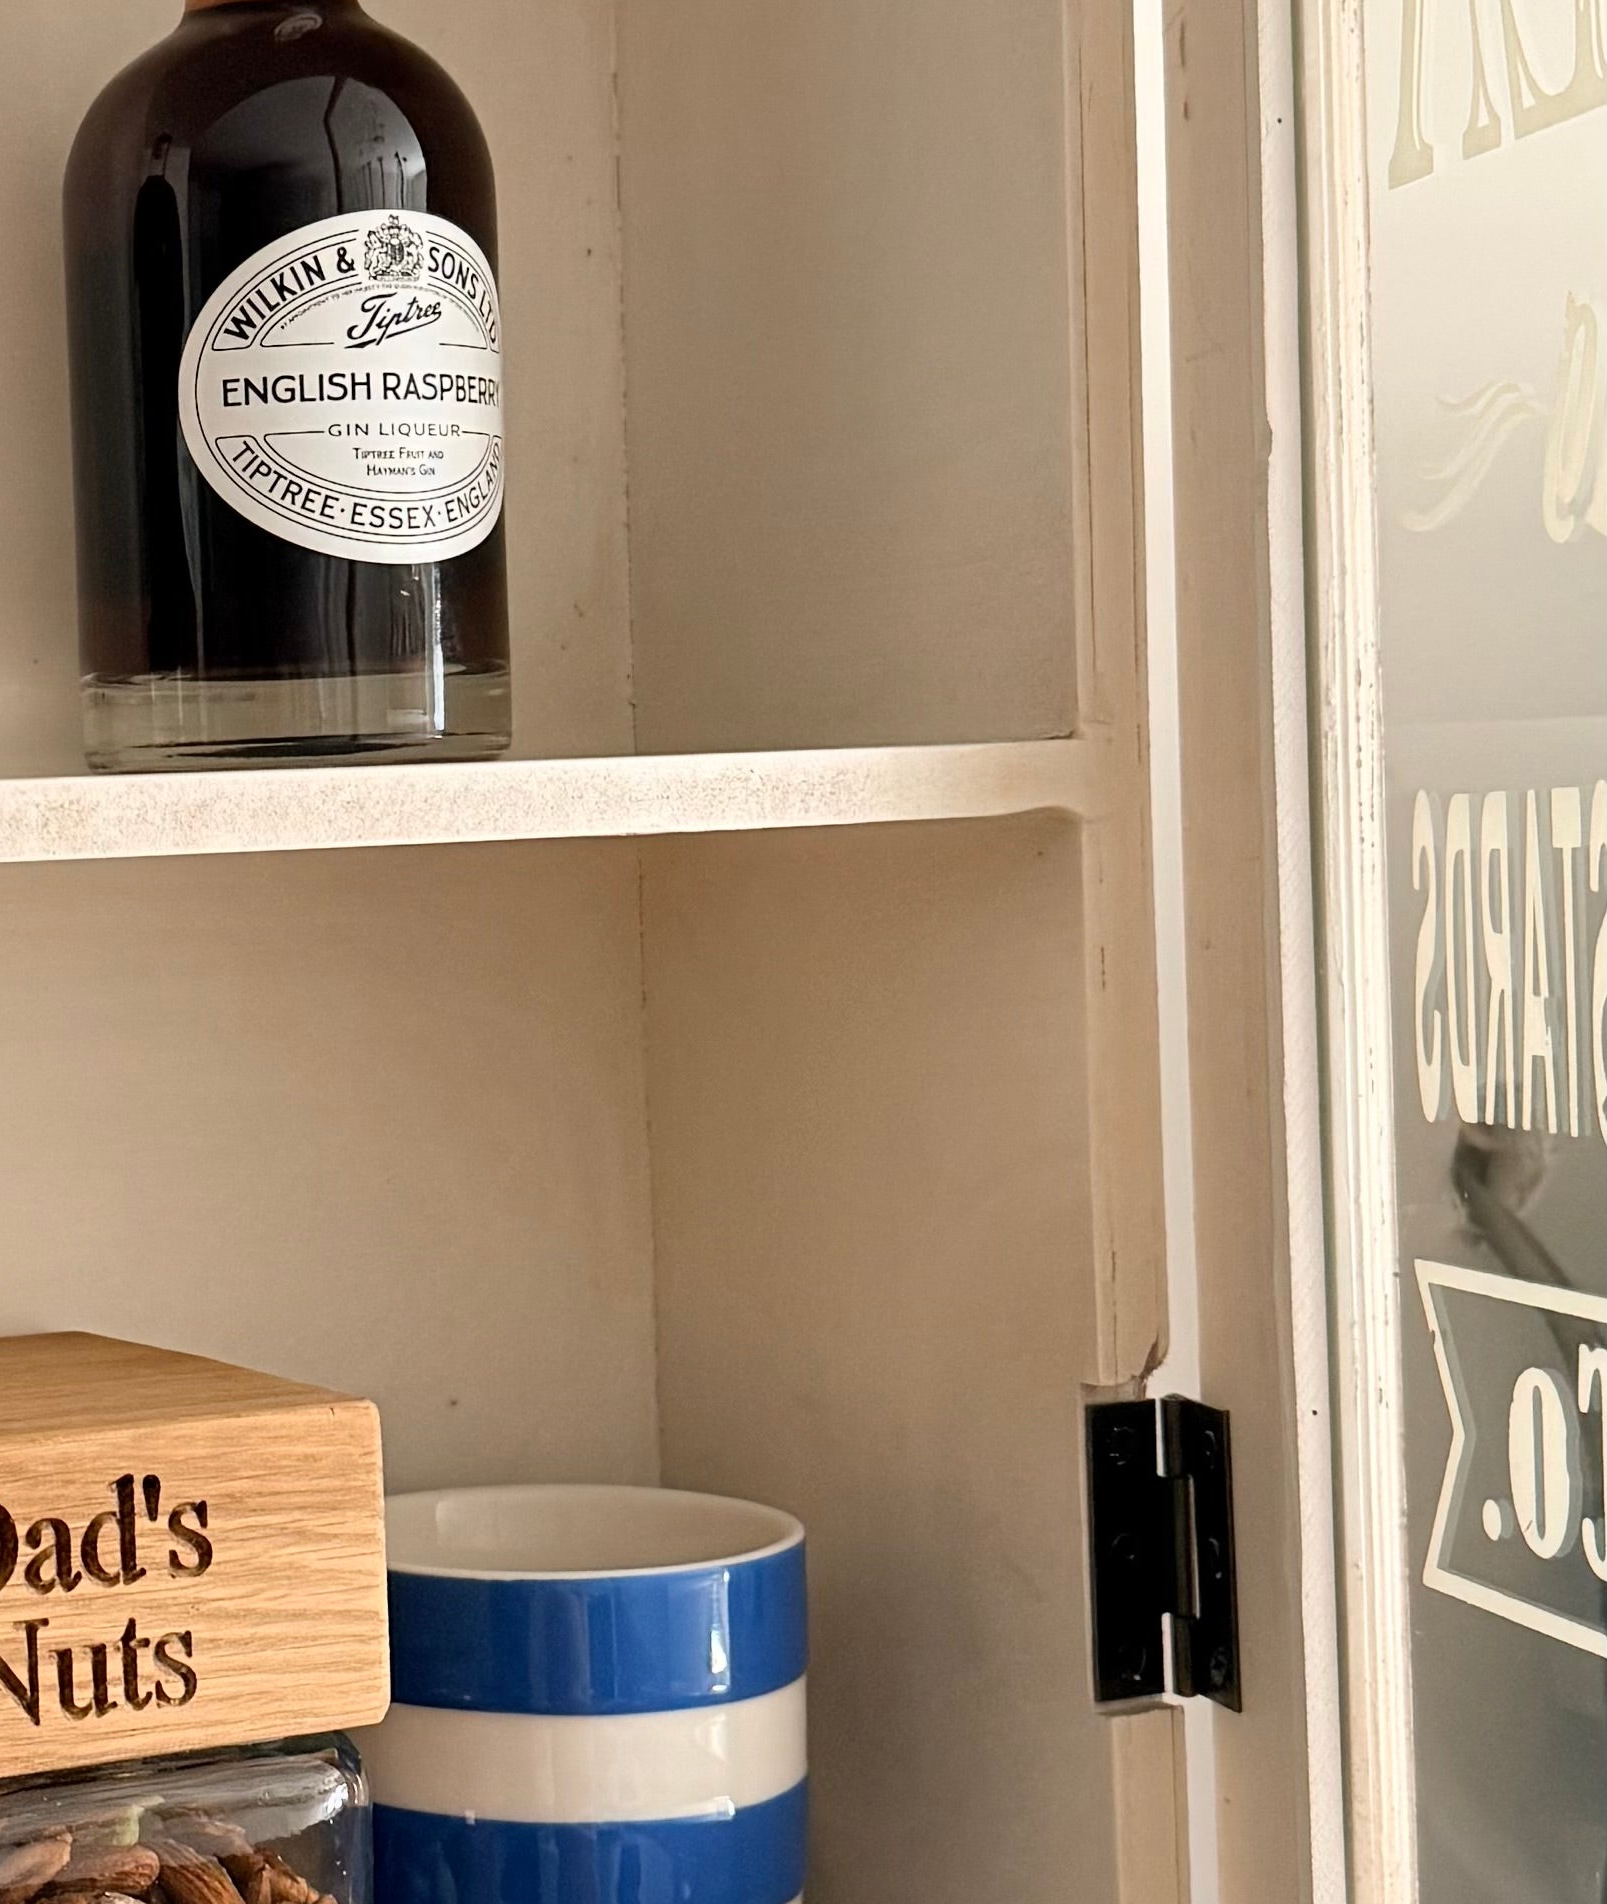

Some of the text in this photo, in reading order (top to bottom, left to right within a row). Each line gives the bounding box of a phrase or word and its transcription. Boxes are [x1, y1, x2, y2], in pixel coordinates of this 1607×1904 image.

[223, 254, 327, 342] WILKIN
[335, 246, 356, 274] &
[427, 246, 479, 300] SONS
[344, 291, 442, 349] Tiptree
[221, 372, 371, 408] ENGLISH
[327, 422, 461, 438] GIN LIQUEUR
[232, 440, 340, 519] TIPTREE
[350, 501, 436, 530] ESSEX
